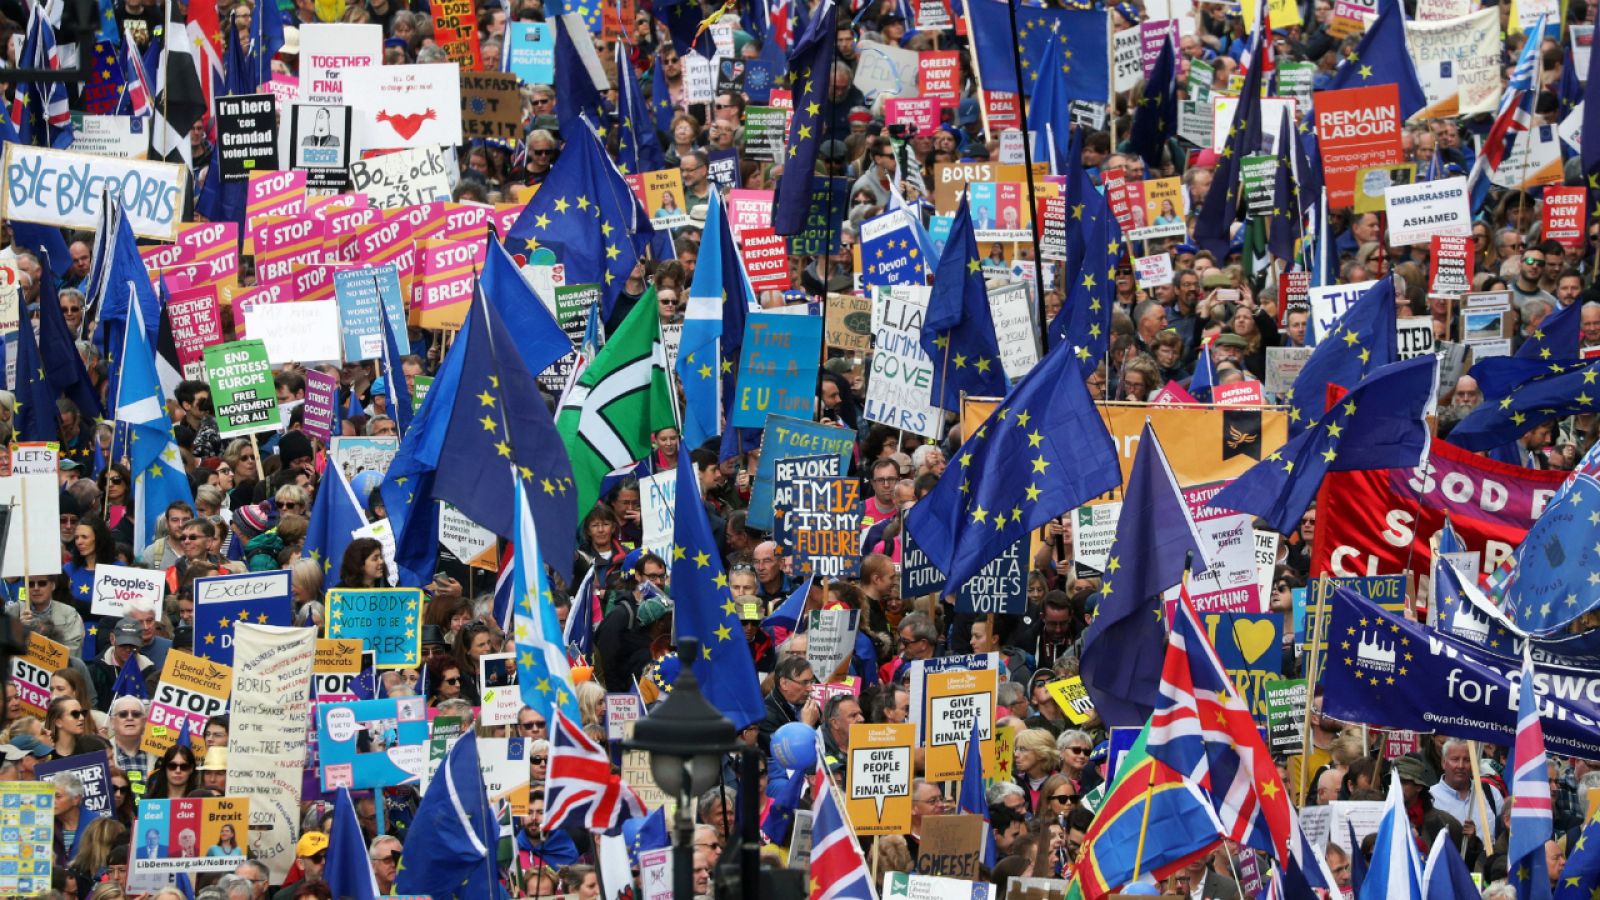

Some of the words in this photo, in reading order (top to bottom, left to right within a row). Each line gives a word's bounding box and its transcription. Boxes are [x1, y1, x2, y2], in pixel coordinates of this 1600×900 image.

[437, 16, 460, 28] DID
[457, 26, 472, 38] IT
[1421, 45, 1478, 60] BANNER
[311, 55, 371, 67] TOGETHER
[921, 57, 956, 68] GREEN
[325, 70, 339, 79] for
[926, 70, 952, 79] NEW
[692, 78, 710, 86] THE
[926, 80, 952, 90] DEAL
[990, 91, 1013, 100] NEW
[219, 101, 241, 115] I'm
[243, 99, 272, 115] here
[896, 101, 931, 110] TOGETHER
[989, 102, 1014, 110] DEAL
[747, 112, 787, 120] MIGRANTS
[896, 115, 916, 124] FINAL
[917, 114, 931, 123] SAY
[1320, 104, 1396, 125] REMAIN
[237, 118, 256, 128] 'cos
[1320, 121, 1396, 140] LABOUR
[222, 129, 272, 146] Grandad
[223, 148, 248, 159] voted
[249, 146, 273, 156] leave
[1324, 150, 1382, 163] Campaigning
[1385, 149, 1396, 157] to
[351, 148, 445, 191] BOLLOCKS
[942, 165, 990, 182] BORIS
[8, 156, 57, 208] BYE
[56, 163, 107, 215] BYE
[106, 169, 182, 224] BORIS
[255, 173, 295, 198] STOP
[393, 184, 409, 192] TO
[650, 181, 678, 191] Brexit
[1151, 190, 1176, 198] Brexit
[1390, 188, 1463, 206] EMBARRASSED
[1546, 194, 1583, 204] GREEN
[1551, 206, 1577, 216] NEW
[332, 210, 374, 234] STOP
[447, 209, 486, 230] STOP
[738, 212, 759, 223] FOR
[1403, 211, 1459, 227] ASHAMED
[1550, 218, 1577, 228] DEAL
[184, 224, 225, 248] STOP
[274, 220, 313, 245] STOP
[365, 223, 400, 252] STOP
[745, 235, 782, 247] REMAIN
[1439, 236, 1466, 244] MARCH
[745, 247, 785, 258] REFORM
[792, 239, 820, 255] EU
[435, 246, 479, 269] STOP
[1438, 250, 1467, 258] OCCUPY
[749, 259, 784, 271] REVOLT
[878, 256, 907, 275] Devon
[1438, 267, 1465, 275] DOWN
[337, 266, 394, 279] CAPITULATION
[888, 272, 900, 282] for
[297, 267, 326, 292] STOP
[1438, 276, 1464, 284] BORIS
[557, 290, 598, 301] MIGRANTS
[167, 298, 213, 316] TOGETHER
[173, 314, 191, 326] FOR
[194, 311, 210, 324] THE
[198, 321, 216, 337] SAY
[224, 351, 250, 364] END
[209, 361, 269, 379] FORTRESS
[786, 360, 798, 377] A
[873, 352, 932, 389] GOVE
[218, 374, 266, 390] EUROPE
[308, 379, 332, 392] MARCH
[234, 391, 256, 401] FREE
[308, 392, 330, 404] STRIKE
[1221, 386, 1253, 398] DEFEND
[1217, 393, 1260, 405] MIGRANTS
[219, 398, 273, 415] MOVEMENT
[304, 404, 331, 418] OCCUPY
[230, 414, 251, 425] FOR
[252, 411, 268, 421] ALL
[864, 400, 927, 432] LIARS
[776, 427, 853, 455] TOGETHER
[17, 450, 52, 462] LET'S
[12, 466, 30, 474] ALL
[777, 456, 839, 481] REVOKE
[1409, 465, 1509, 511] SOD
[831, 479, 859, 512] 17
[836, 514, 859, 530] MY
[799, 530, 860, 556] FUTURE
[1255, 534, 1274, 548] THE
[808, 556, 845, 576] TOO!
[103, 575, 155, 591] People's
[961, 576, 1021, 596] PEOPLE'S
[1367, 578, 1400, 598] VOTE
[205, 580, 277, 600] Exeter
[342, 595, 408, 612] NOBODY
[971, 594, 1007, 613] VOTE
[342, 616, 372, 628] VOTED
[949, 656, 965, 664] NOT
[175, 660, 205, 675] Liberal
[172, 671, 222, 691] Democrats
[237, 677, 271, 693] BORIS
[1446, 668, 1499, 705] for
[501, 688, 512, 696] He
[1268, 688, 1308, 698] MIGRANTS
[160, 685, 221, 716] STOP
[497, 700, 517, 709] loves
[950, 698, 974, 708] GIVE
[1269, 695, 1308, 705] WELCOME
[495, 712, 517, 721] Brexit
[943, 708, 981, 720] PEOPLE
[1270, 711, 1287, 719] STOP
[952, 720, 972, 730] THE
[1273, 724, 1288, 732] STOP
[935, 732, 966, 742] FINAL
[870, 751, 894, 760] GIVE
[864, 762, 900, 772] PEOPLE
[872, 773, 890, 783] THE
[490, 783, 501, 791] EU
[855, 786, 885, 796] FINAL
[888, 784, 906, 794] SAY
[85, 796, 108, 811] SAY
[147, 803, 161, 811] No
[180, 802, 193, 810] No
[219, 801, 234, 810] No
[145, 810, 164, 820] deal
[177, 810, 195, 819] clue
[209, 812, 242, 822] Brexit
[919, 852, 980, 877] CHEESE?
